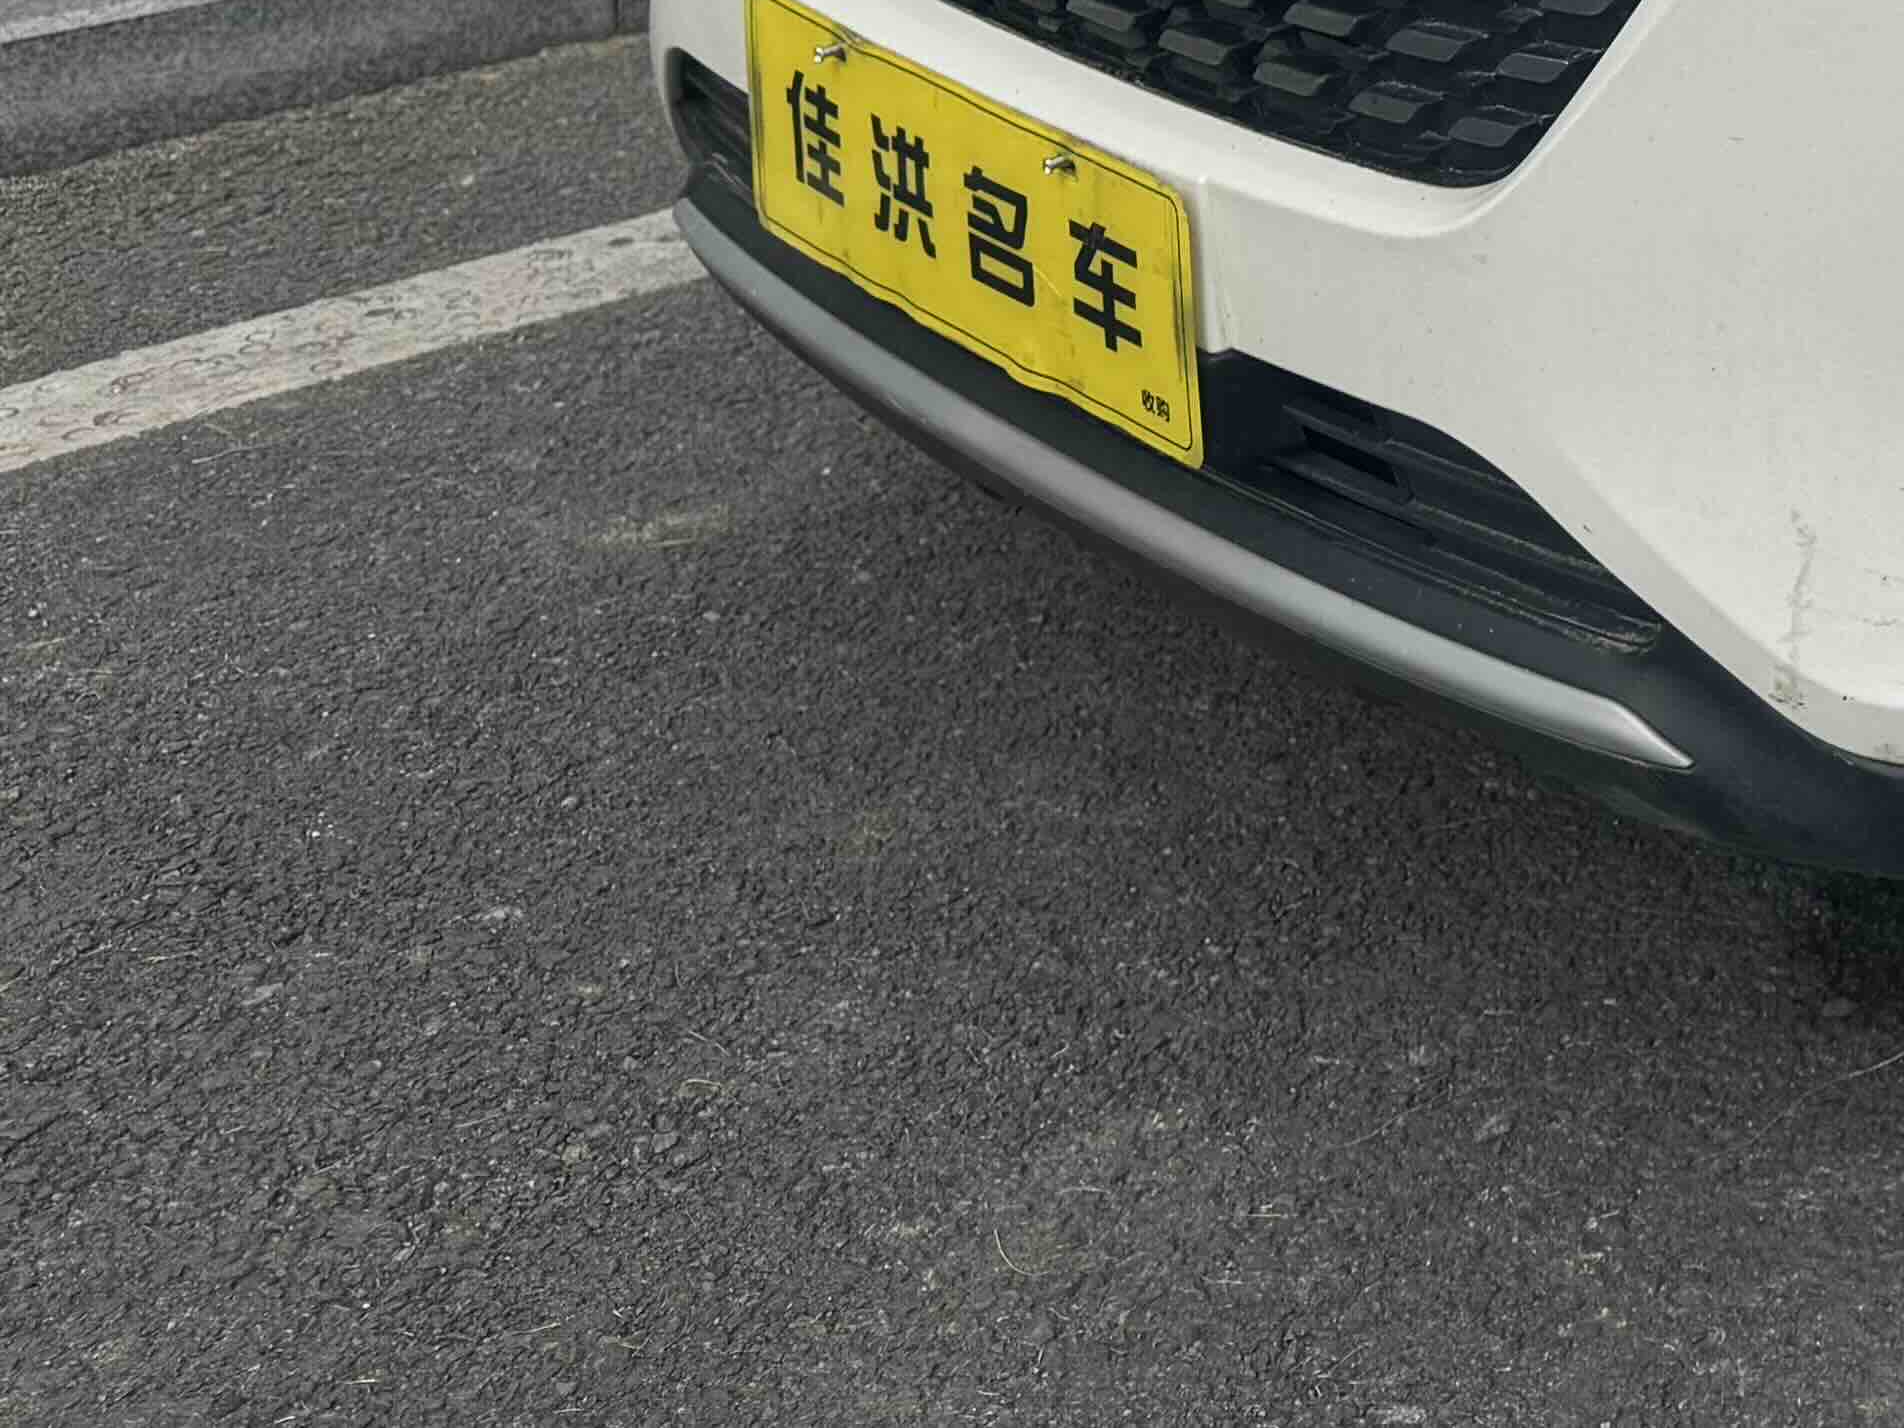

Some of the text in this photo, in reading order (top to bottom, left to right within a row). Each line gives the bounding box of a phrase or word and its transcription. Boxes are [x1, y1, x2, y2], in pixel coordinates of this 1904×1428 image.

[785, 70, 1144, 353] 佳洪名车
[1140, 389, 1172, 423] 收购
